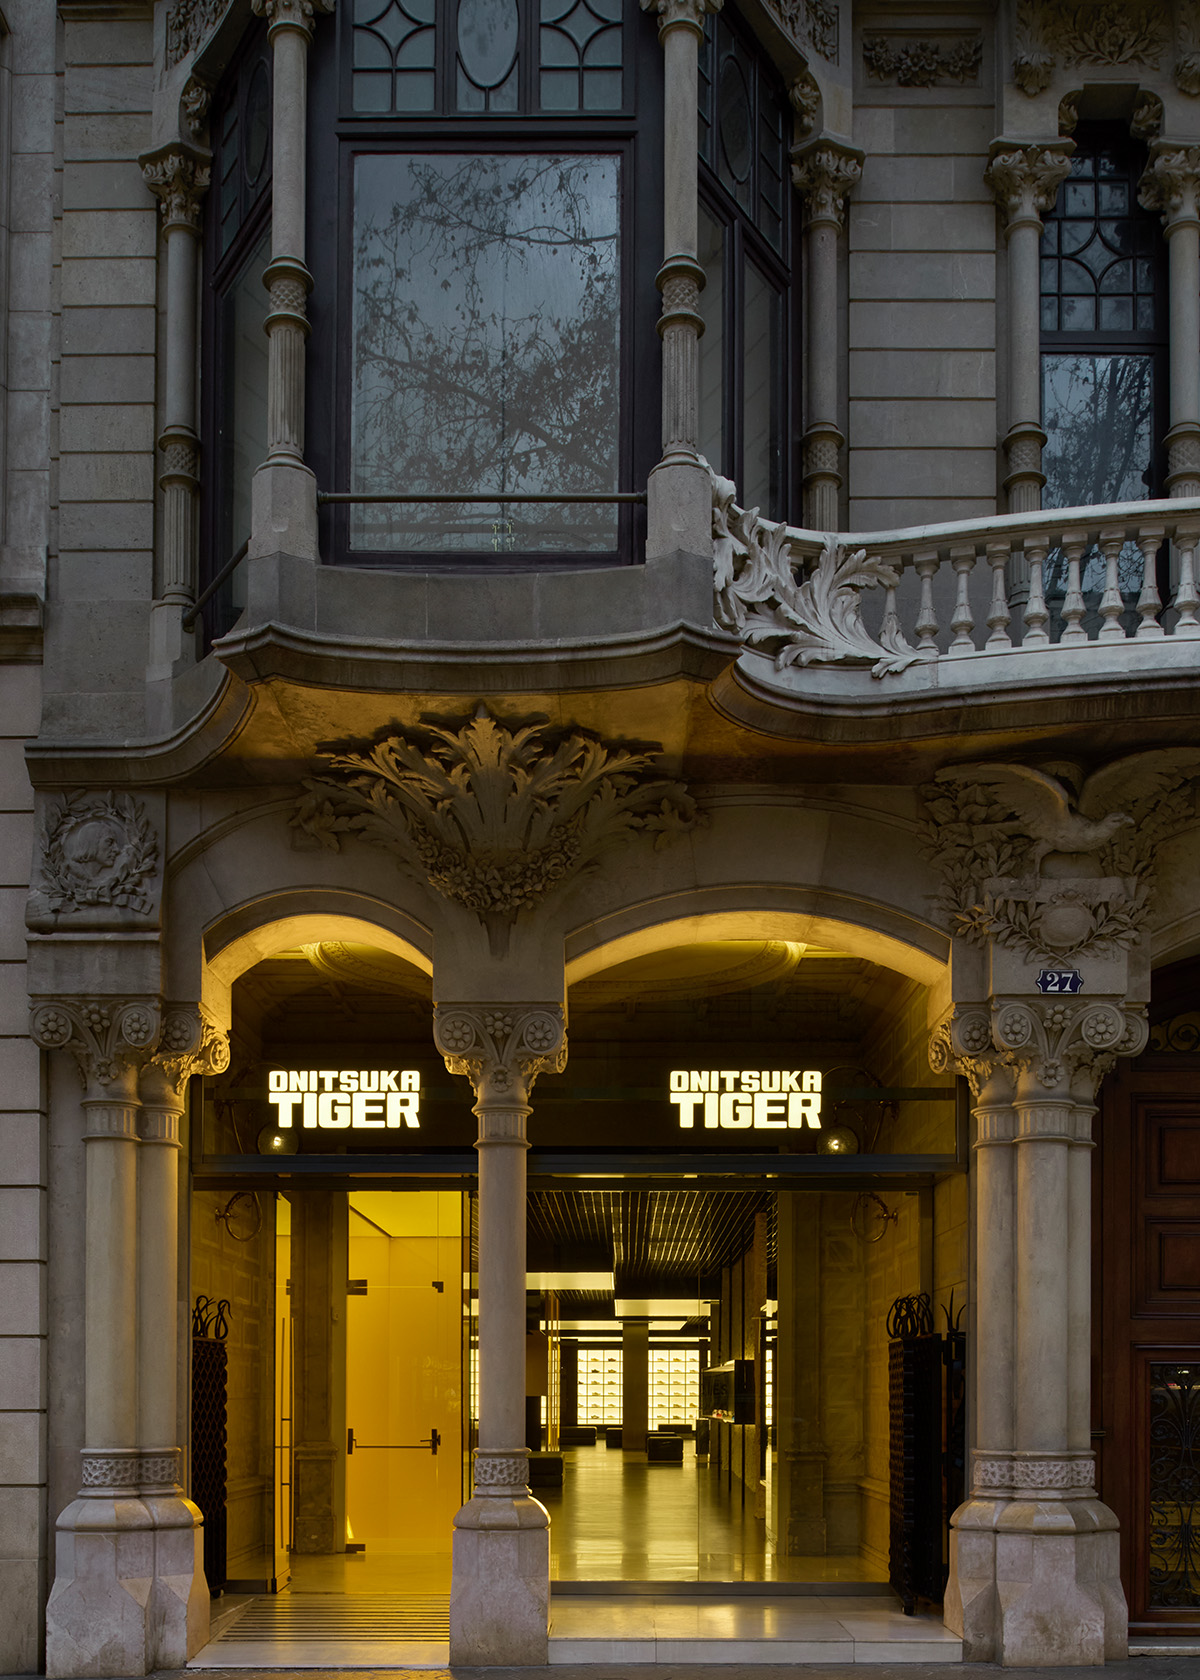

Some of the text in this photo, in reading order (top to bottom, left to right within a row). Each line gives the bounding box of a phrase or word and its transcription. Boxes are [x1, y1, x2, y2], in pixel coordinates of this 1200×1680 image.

[1046, 972, 1074, 992] 27
[268, 1070, 421, 1092] ONITSUKA
[669, 1070, 823, 1093] ONITSUKA
[268, 1092, 421, 1129] TIGER
[669, 1092, 823, 1129] TIGER
